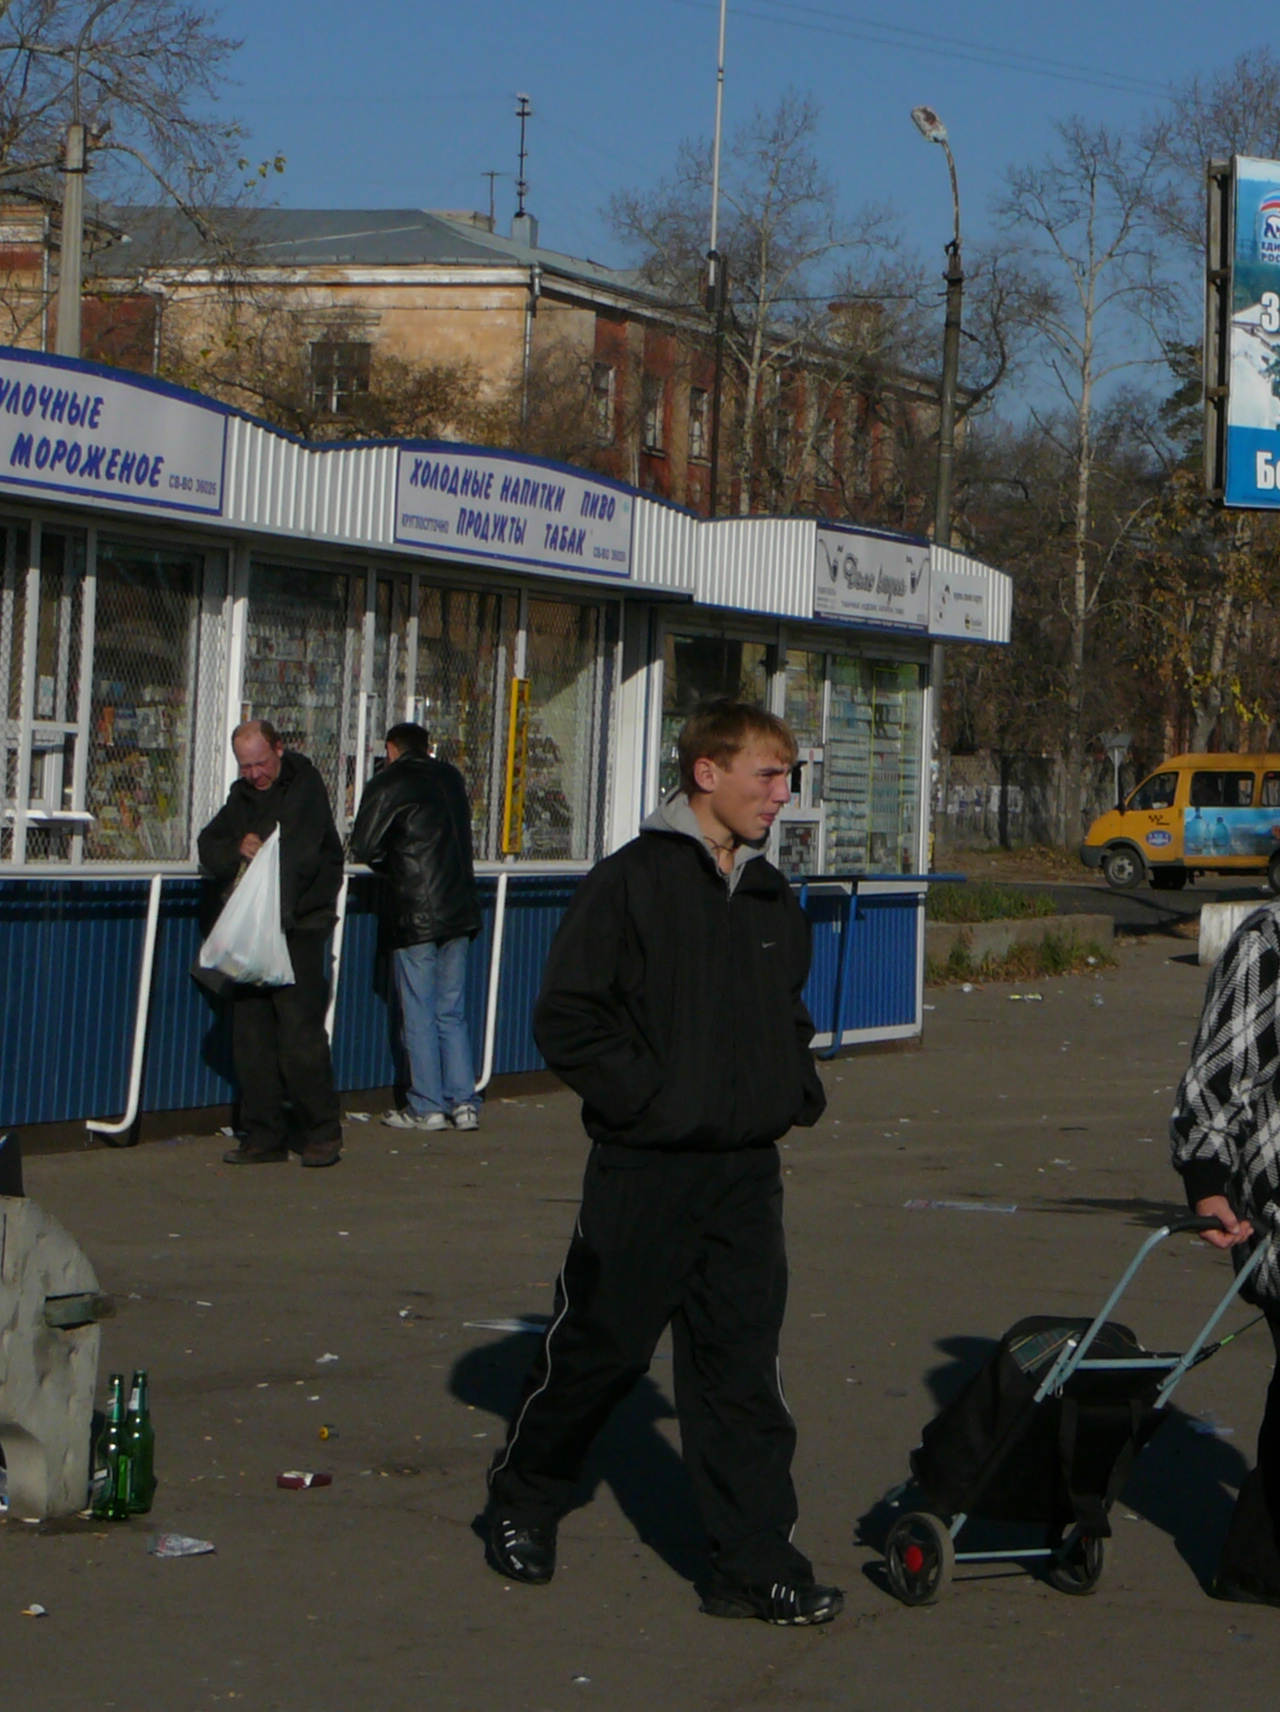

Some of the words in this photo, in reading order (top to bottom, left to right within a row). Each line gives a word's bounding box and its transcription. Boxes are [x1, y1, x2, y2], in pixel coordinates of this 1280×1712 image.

[9, 432, 165, 487] МОРОЖЕНОЕ
[410, 457, 495, 500] ХОЛОДНЫЕ
[500, 475, 566, 513] НАПИТКИ
[580, 490, 617, 523] ПИВО
[456, 507, 528, 546] ПРОДУКТЫ
[544, 523, 587, 557] ТАБАК
